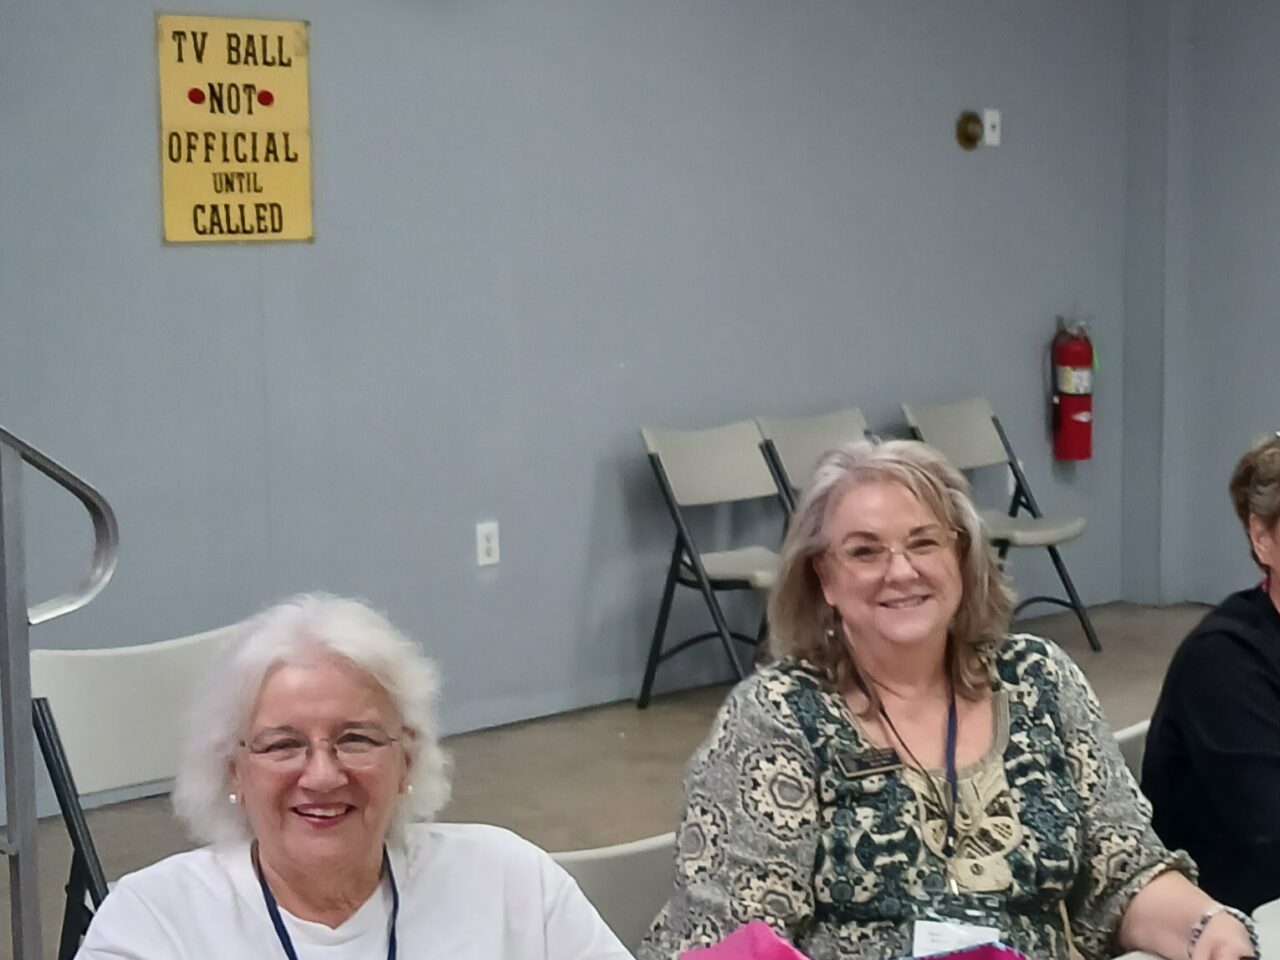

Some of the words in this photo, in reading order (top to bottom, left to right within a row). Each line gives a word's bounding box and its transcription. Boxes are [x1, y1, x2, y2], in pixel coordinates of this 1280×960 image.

[171, 30, 208, 64] TV
[226, 32, 292, 67] BALL
[207, 82, 257, 115] NOT
[168, 131, 298, 164] OFFICIAL
[212, 171, 263, 194] UNTIL
[192, 202, 284, 235] CALLED
